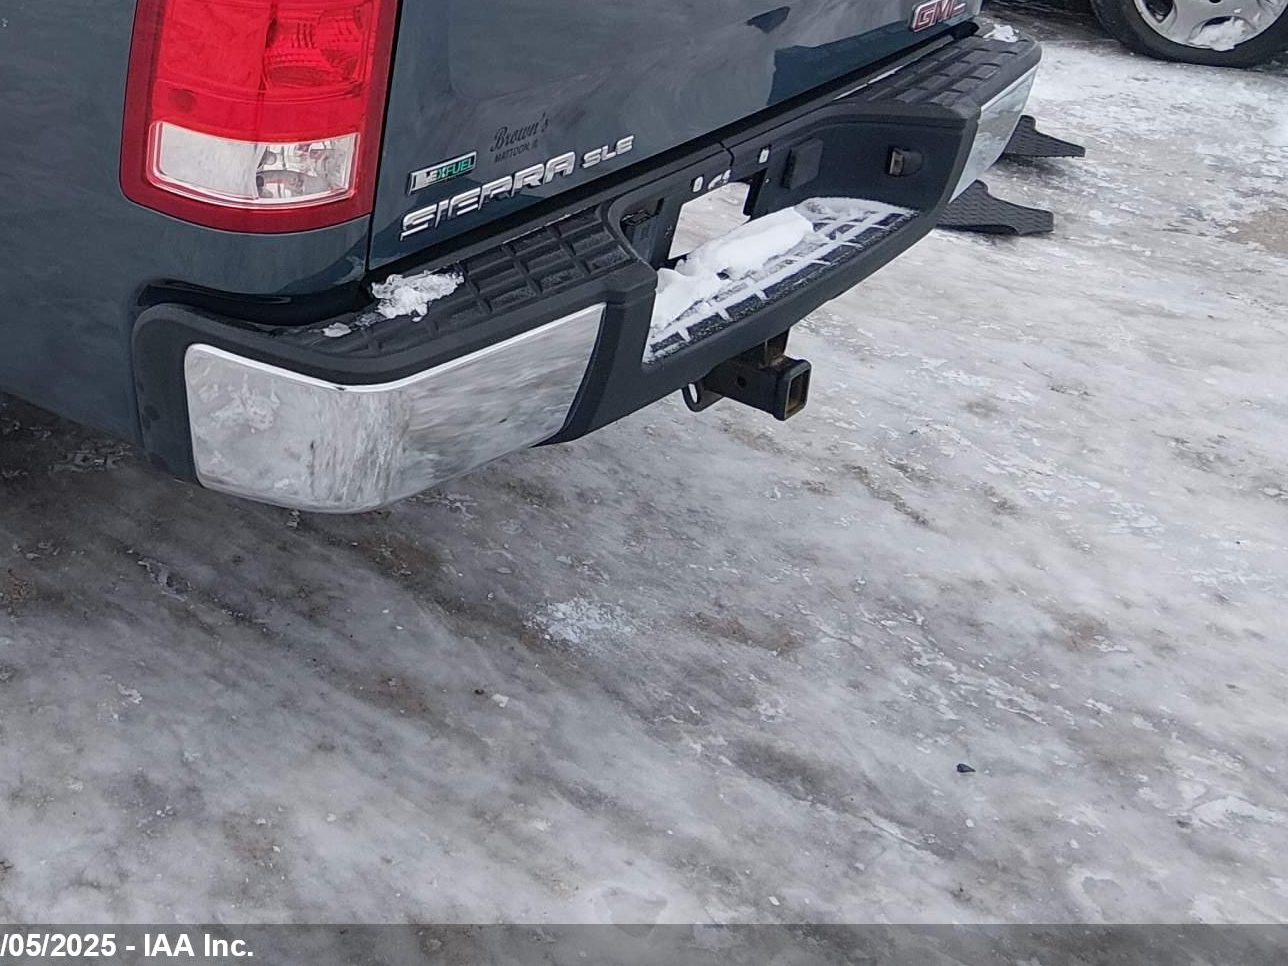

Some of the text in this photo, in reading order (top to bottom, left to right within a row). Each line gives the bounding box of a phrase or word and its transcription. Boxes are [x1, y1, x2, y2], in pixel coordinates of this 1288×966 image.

[489, 112, 551, 153] Brown's
[399, 134, 635, 242] SIERRA SLE
